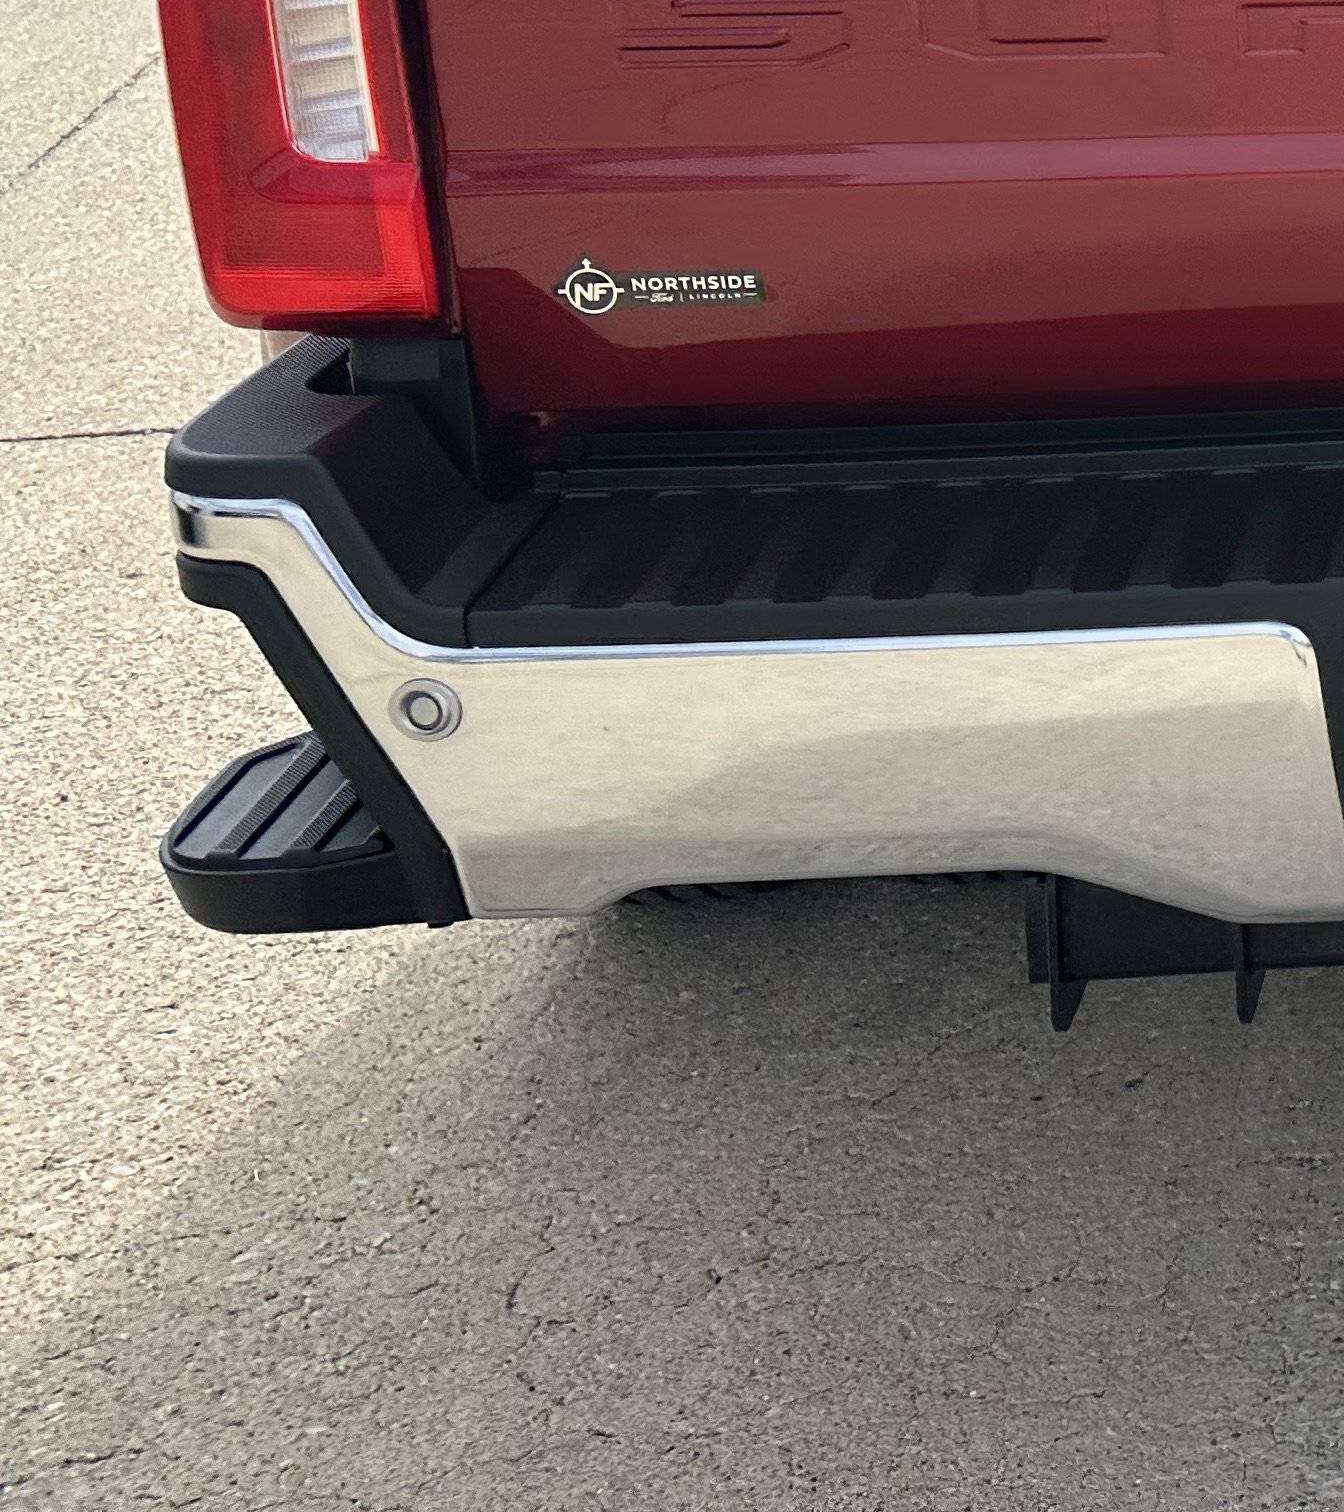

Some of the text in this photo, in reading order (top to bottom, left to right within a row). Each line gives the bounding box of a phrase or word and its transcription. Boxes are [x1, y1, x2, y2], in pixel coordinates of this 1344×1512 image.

[630, 274, 757, 292] NORTHSIDE
[574, 282, 615, 308] NF
[688, 291, 742, 300] LINCOLN
